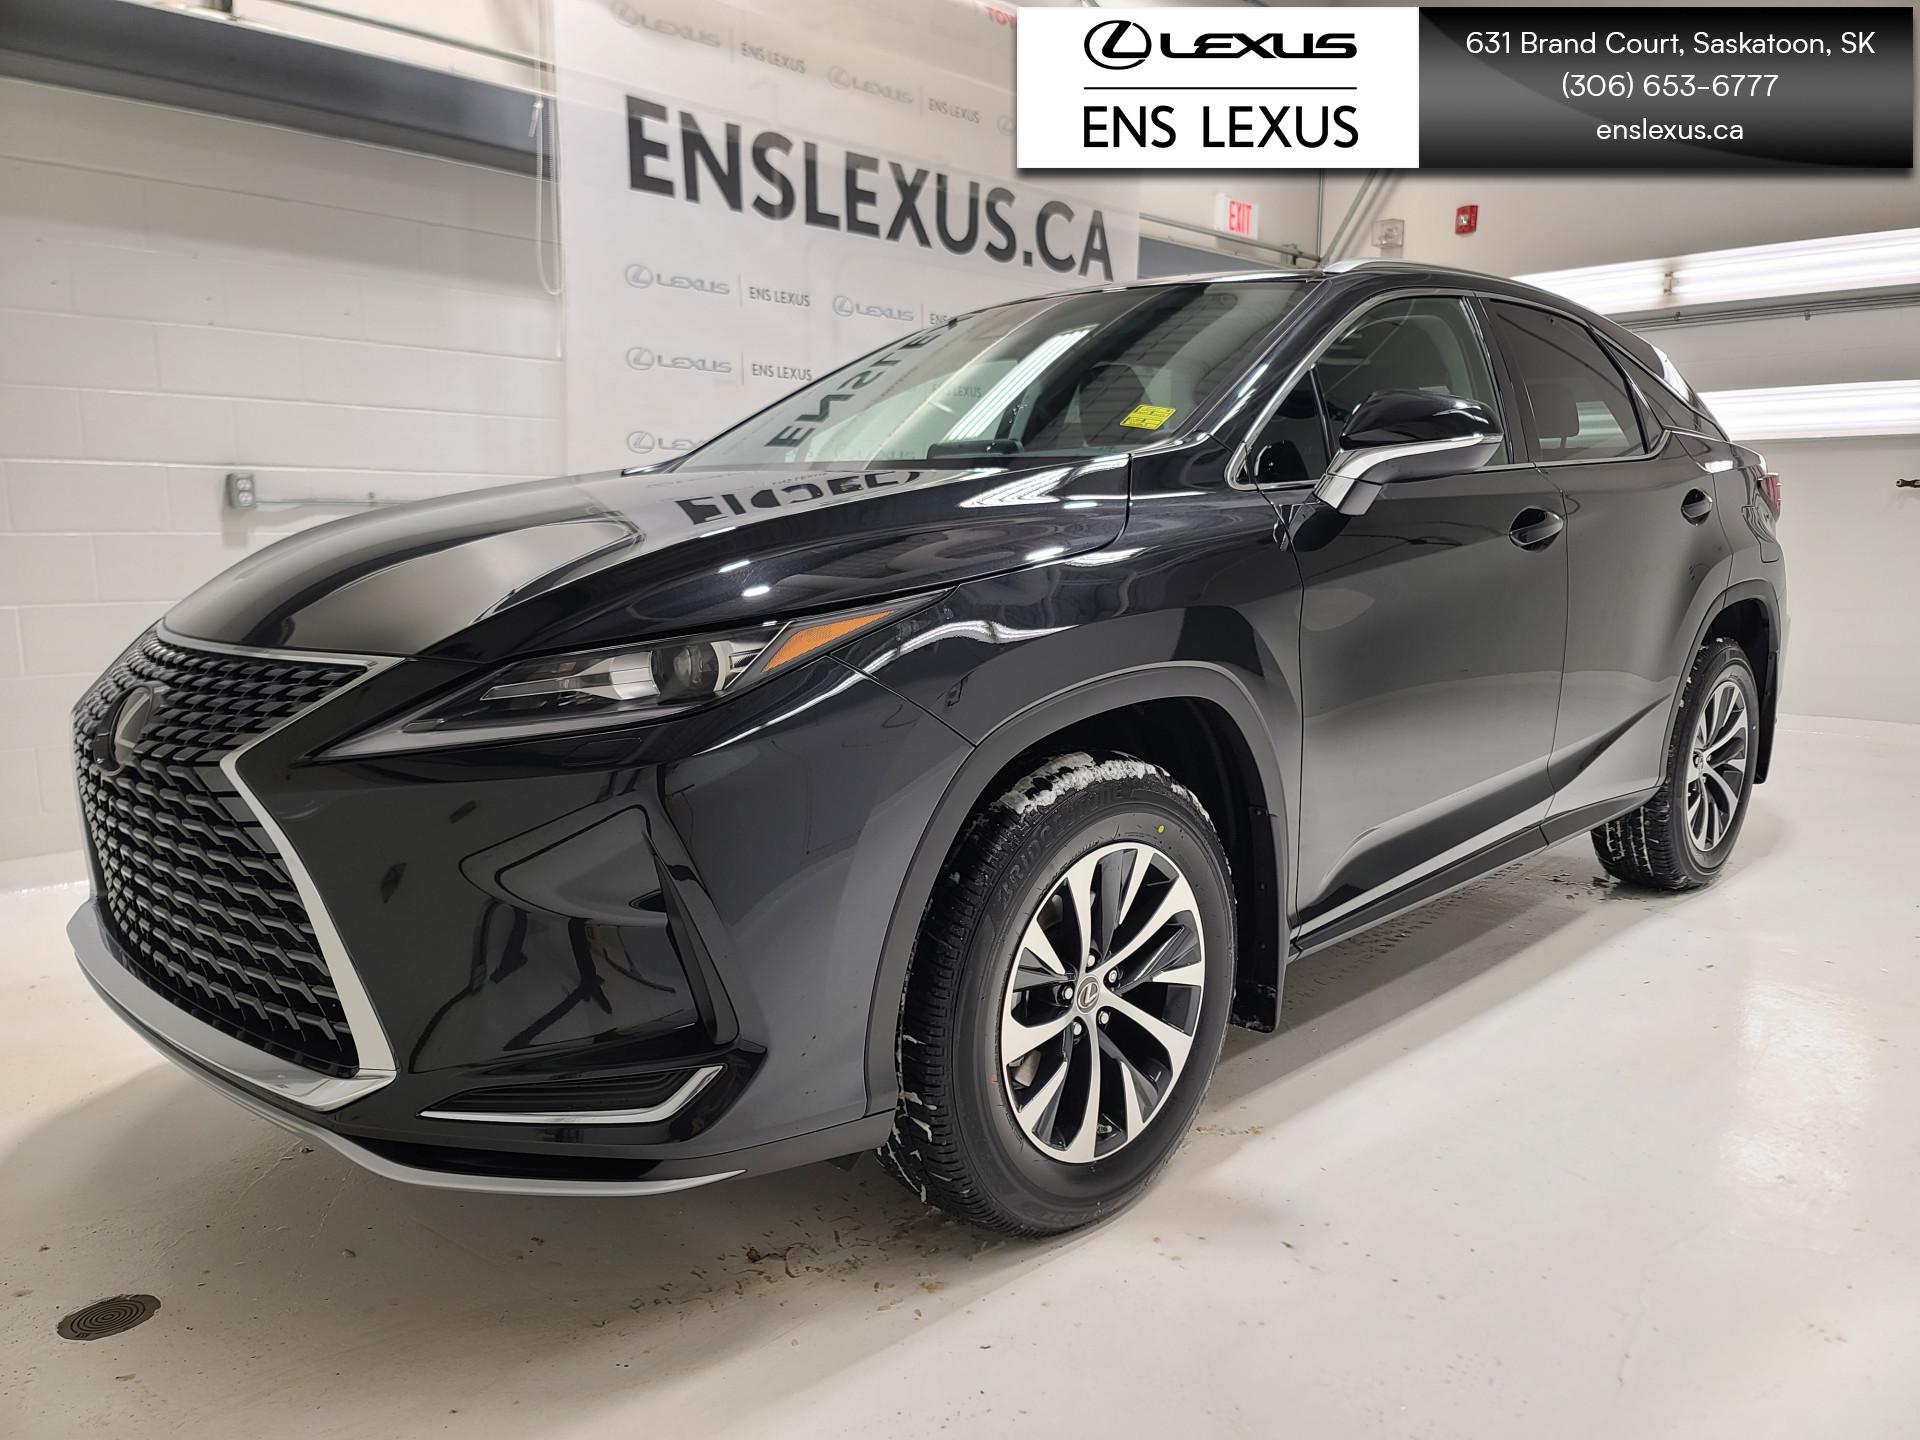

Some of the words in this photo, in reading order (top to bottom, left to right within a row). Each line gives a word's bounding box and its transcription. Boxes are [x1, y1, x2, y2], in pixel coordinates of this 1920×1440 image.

[928, 98, 948, 115] ENS
[950, 105, 980, 124] LEXUS
[625, 94, 1114, 282] ENSLEXUS.CA
[1229, 200, 1252, 236] EXIT
[656, 273, 730, 295] LEXUS
[749, 286, 772, 302] ENS
[774, 290, 811, 307] LEXUS
[854, 303, 914, 322] LEXUS
[657, 355, 732, 373] LEXUS
[752, 363, 774, 378] ENS
[777, 366, 813, 382] LEXUS
